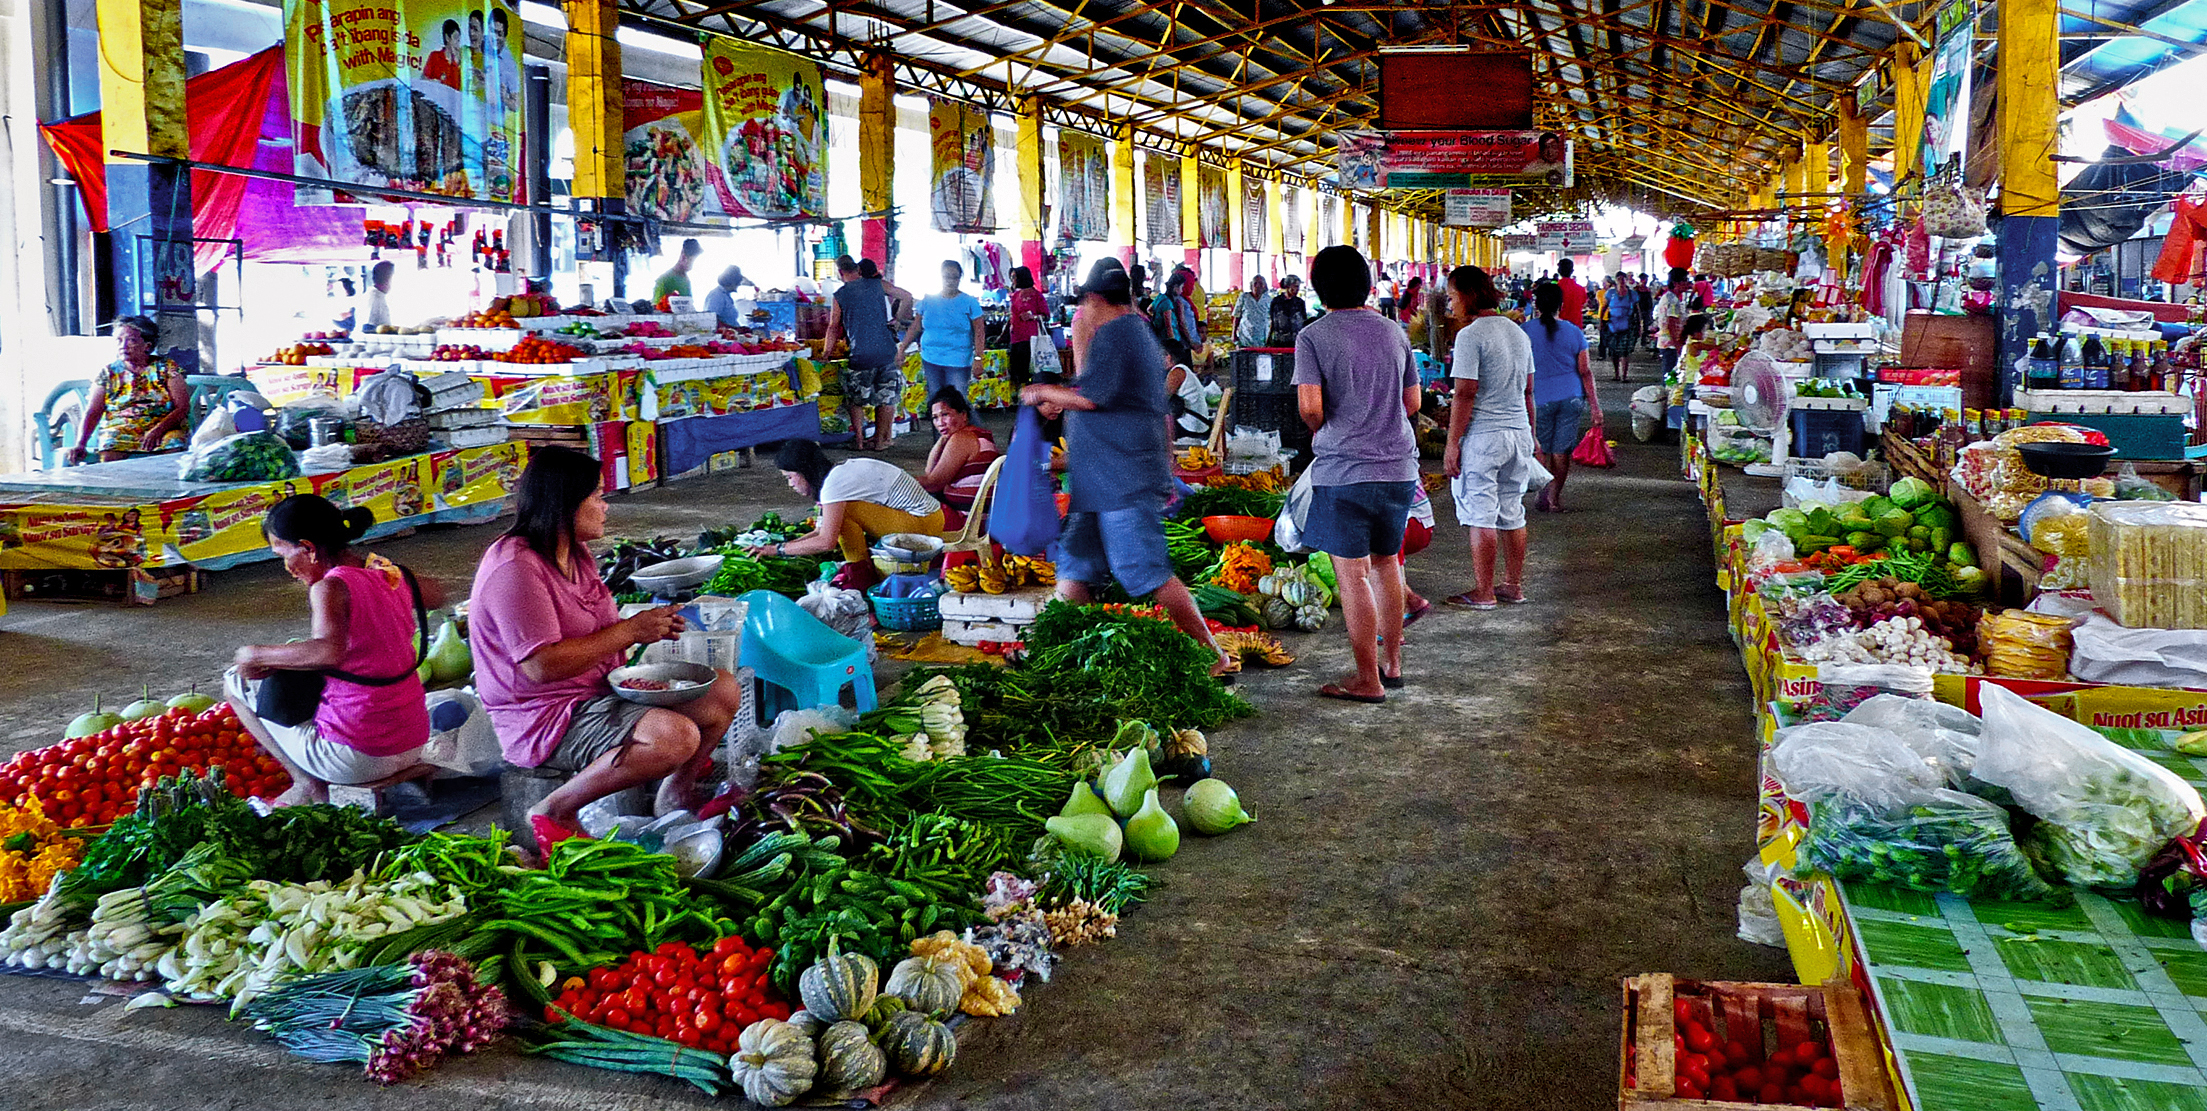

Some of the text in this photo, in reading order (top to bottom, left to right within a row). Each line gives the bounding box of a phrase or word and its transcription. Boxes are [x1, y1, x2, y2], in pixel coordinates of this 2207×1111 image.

[377, 7, 400, 25] ang
[351, 27, 388, 45] ibang
[391, 26, 420, 48] isda
[343, 46, 422, 71] with Magic!
[753, 73, 767, 84] ang
[1431, 138, 1457, 148] your
[1460, 135, 1494, 146] Blood
[1497, 134, 1534, 148] Sugar
[1537, 222, 1567, 231] FARMERS
[49, 528, 62, 539] sa
[2093, 704, 2207, 729] Nuot sa Asi
